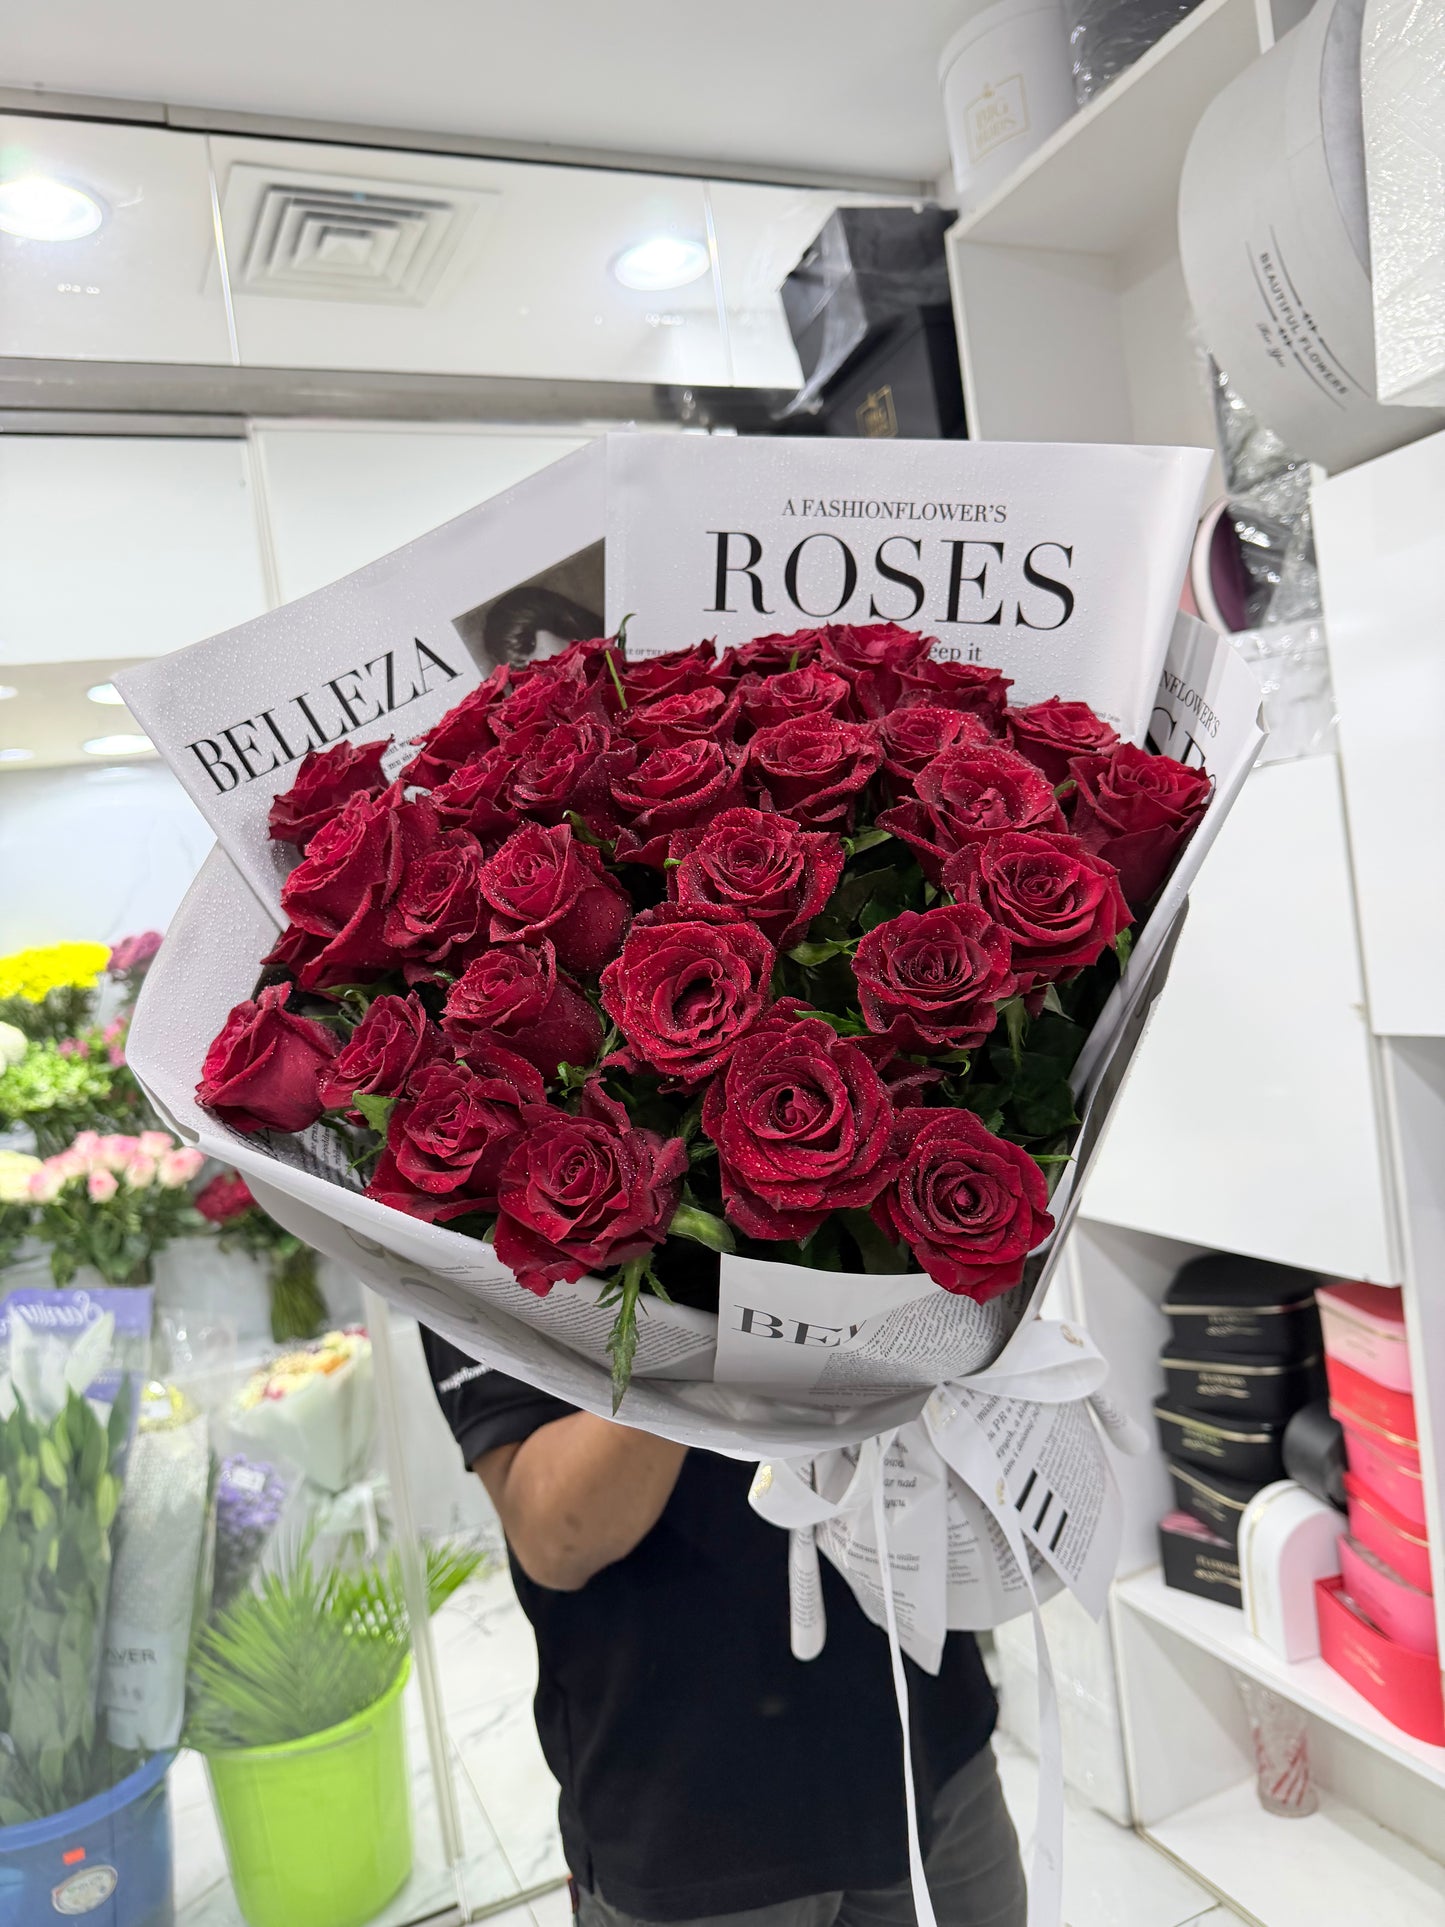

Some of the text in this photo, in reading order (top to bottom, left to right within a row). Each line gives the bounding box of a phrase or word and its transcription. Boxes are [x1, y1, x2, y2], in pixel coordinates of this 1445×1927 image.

[1259, 252, 1349, 395] BEAUTIFUL FLOWERS
[782, 499, 1008, 524] A FASHIONFLOWER'S
[702, 530, 1075, 631] ROSES
[927, 642, 982, 662] eep it
[184, 636, 464, 796] BELLEZA
